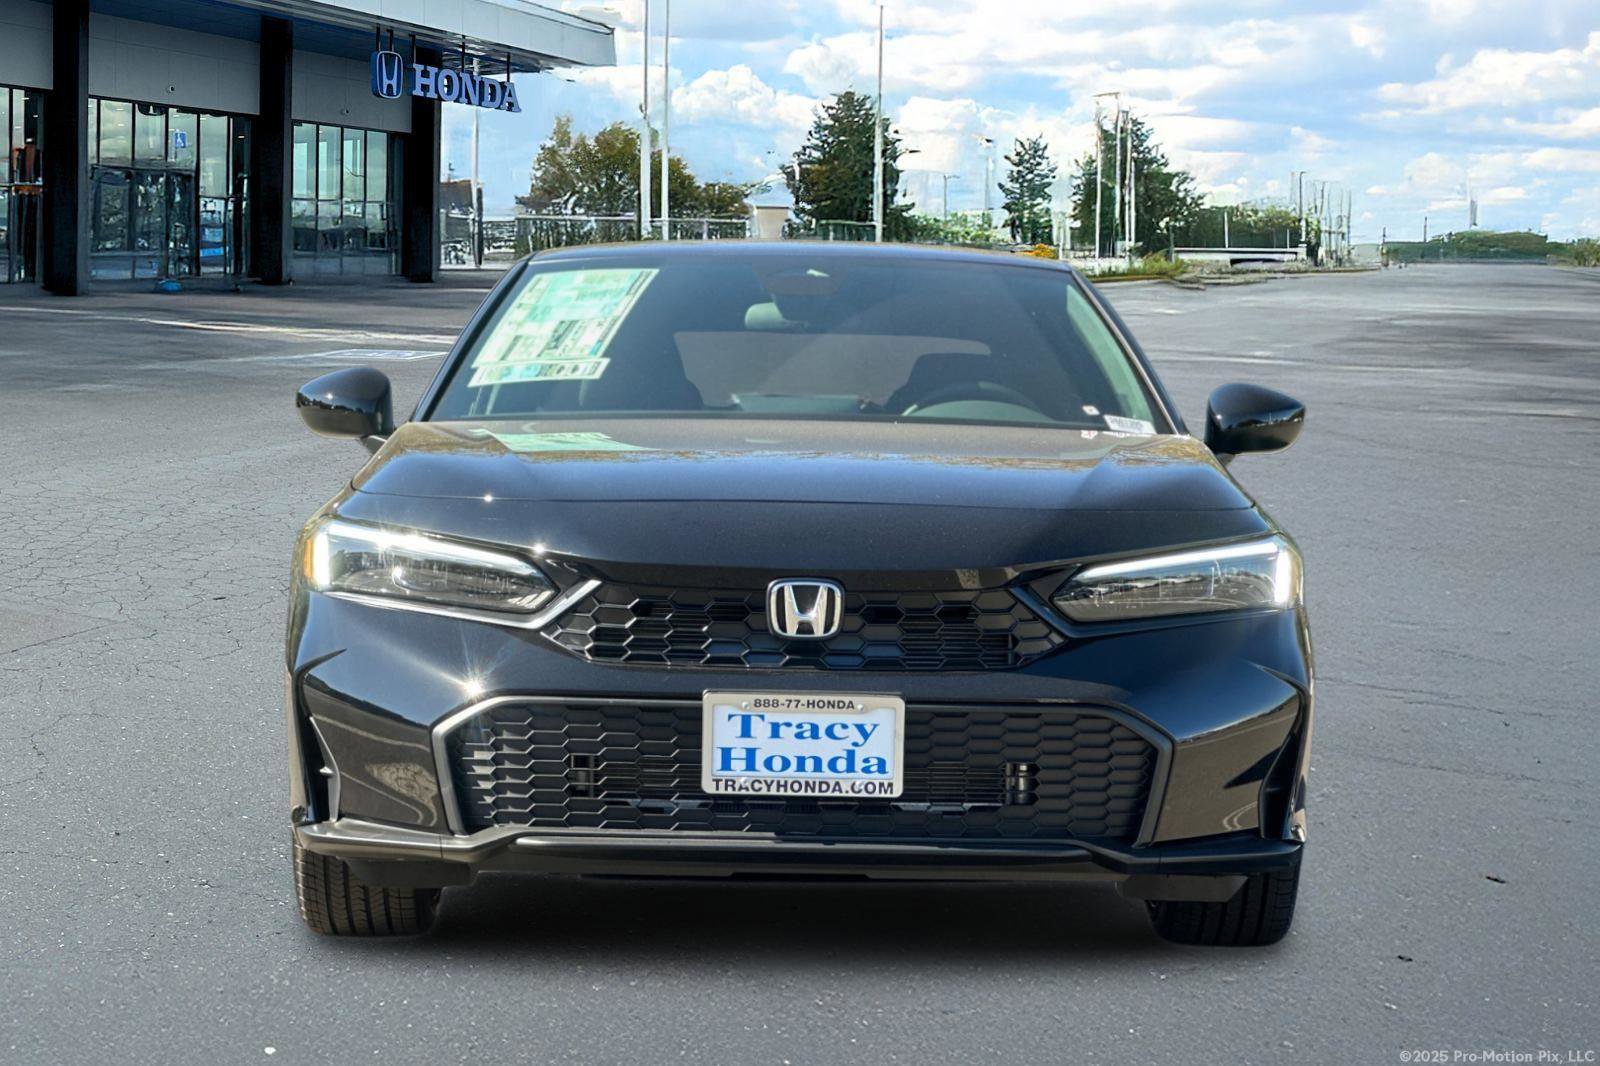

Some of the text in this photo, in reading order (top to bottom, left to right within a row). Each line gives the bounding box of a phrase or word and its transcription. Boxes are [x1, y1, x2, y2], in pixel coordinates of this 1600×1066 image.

[412, 63, 522, 113] HONDA
[753, 698, 855, 710] 888-77-HONDA
[727, 713, 881, 748] Tracy
[716, 746, 889, 775] Honda
[712, 778, 894, 795] TRACYHONDA.COM
